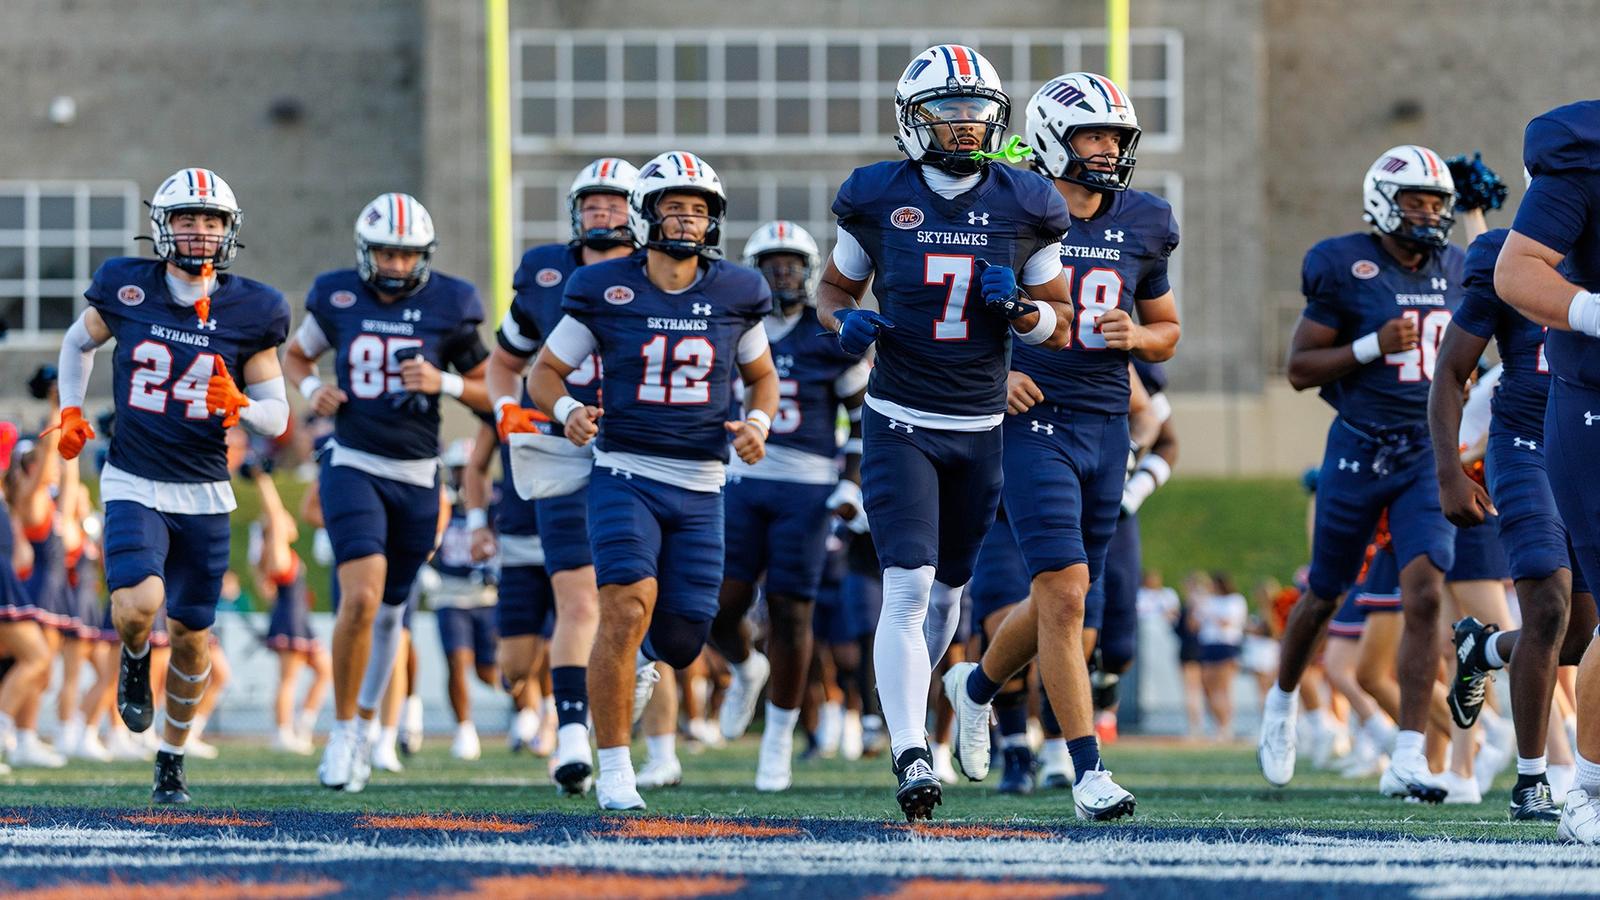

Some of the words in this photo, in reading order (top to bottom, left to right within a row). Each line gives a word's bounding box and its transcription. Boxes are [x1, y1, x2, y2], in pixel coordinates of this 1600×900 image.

[916, 230, 988, 246] SKYHAWKS
[1059, 245, 1120, 260] SKYHAWKS
[924, 253, 975, 340] 7
[1060, 265, 1124, 351] 8
[150, 324, 209, 347] SKYHAWKS
[647, 316, 708, 331] SKYHAWKS
[128, 340, 215, 419] 24
[637, 333, 715, 405] 12
